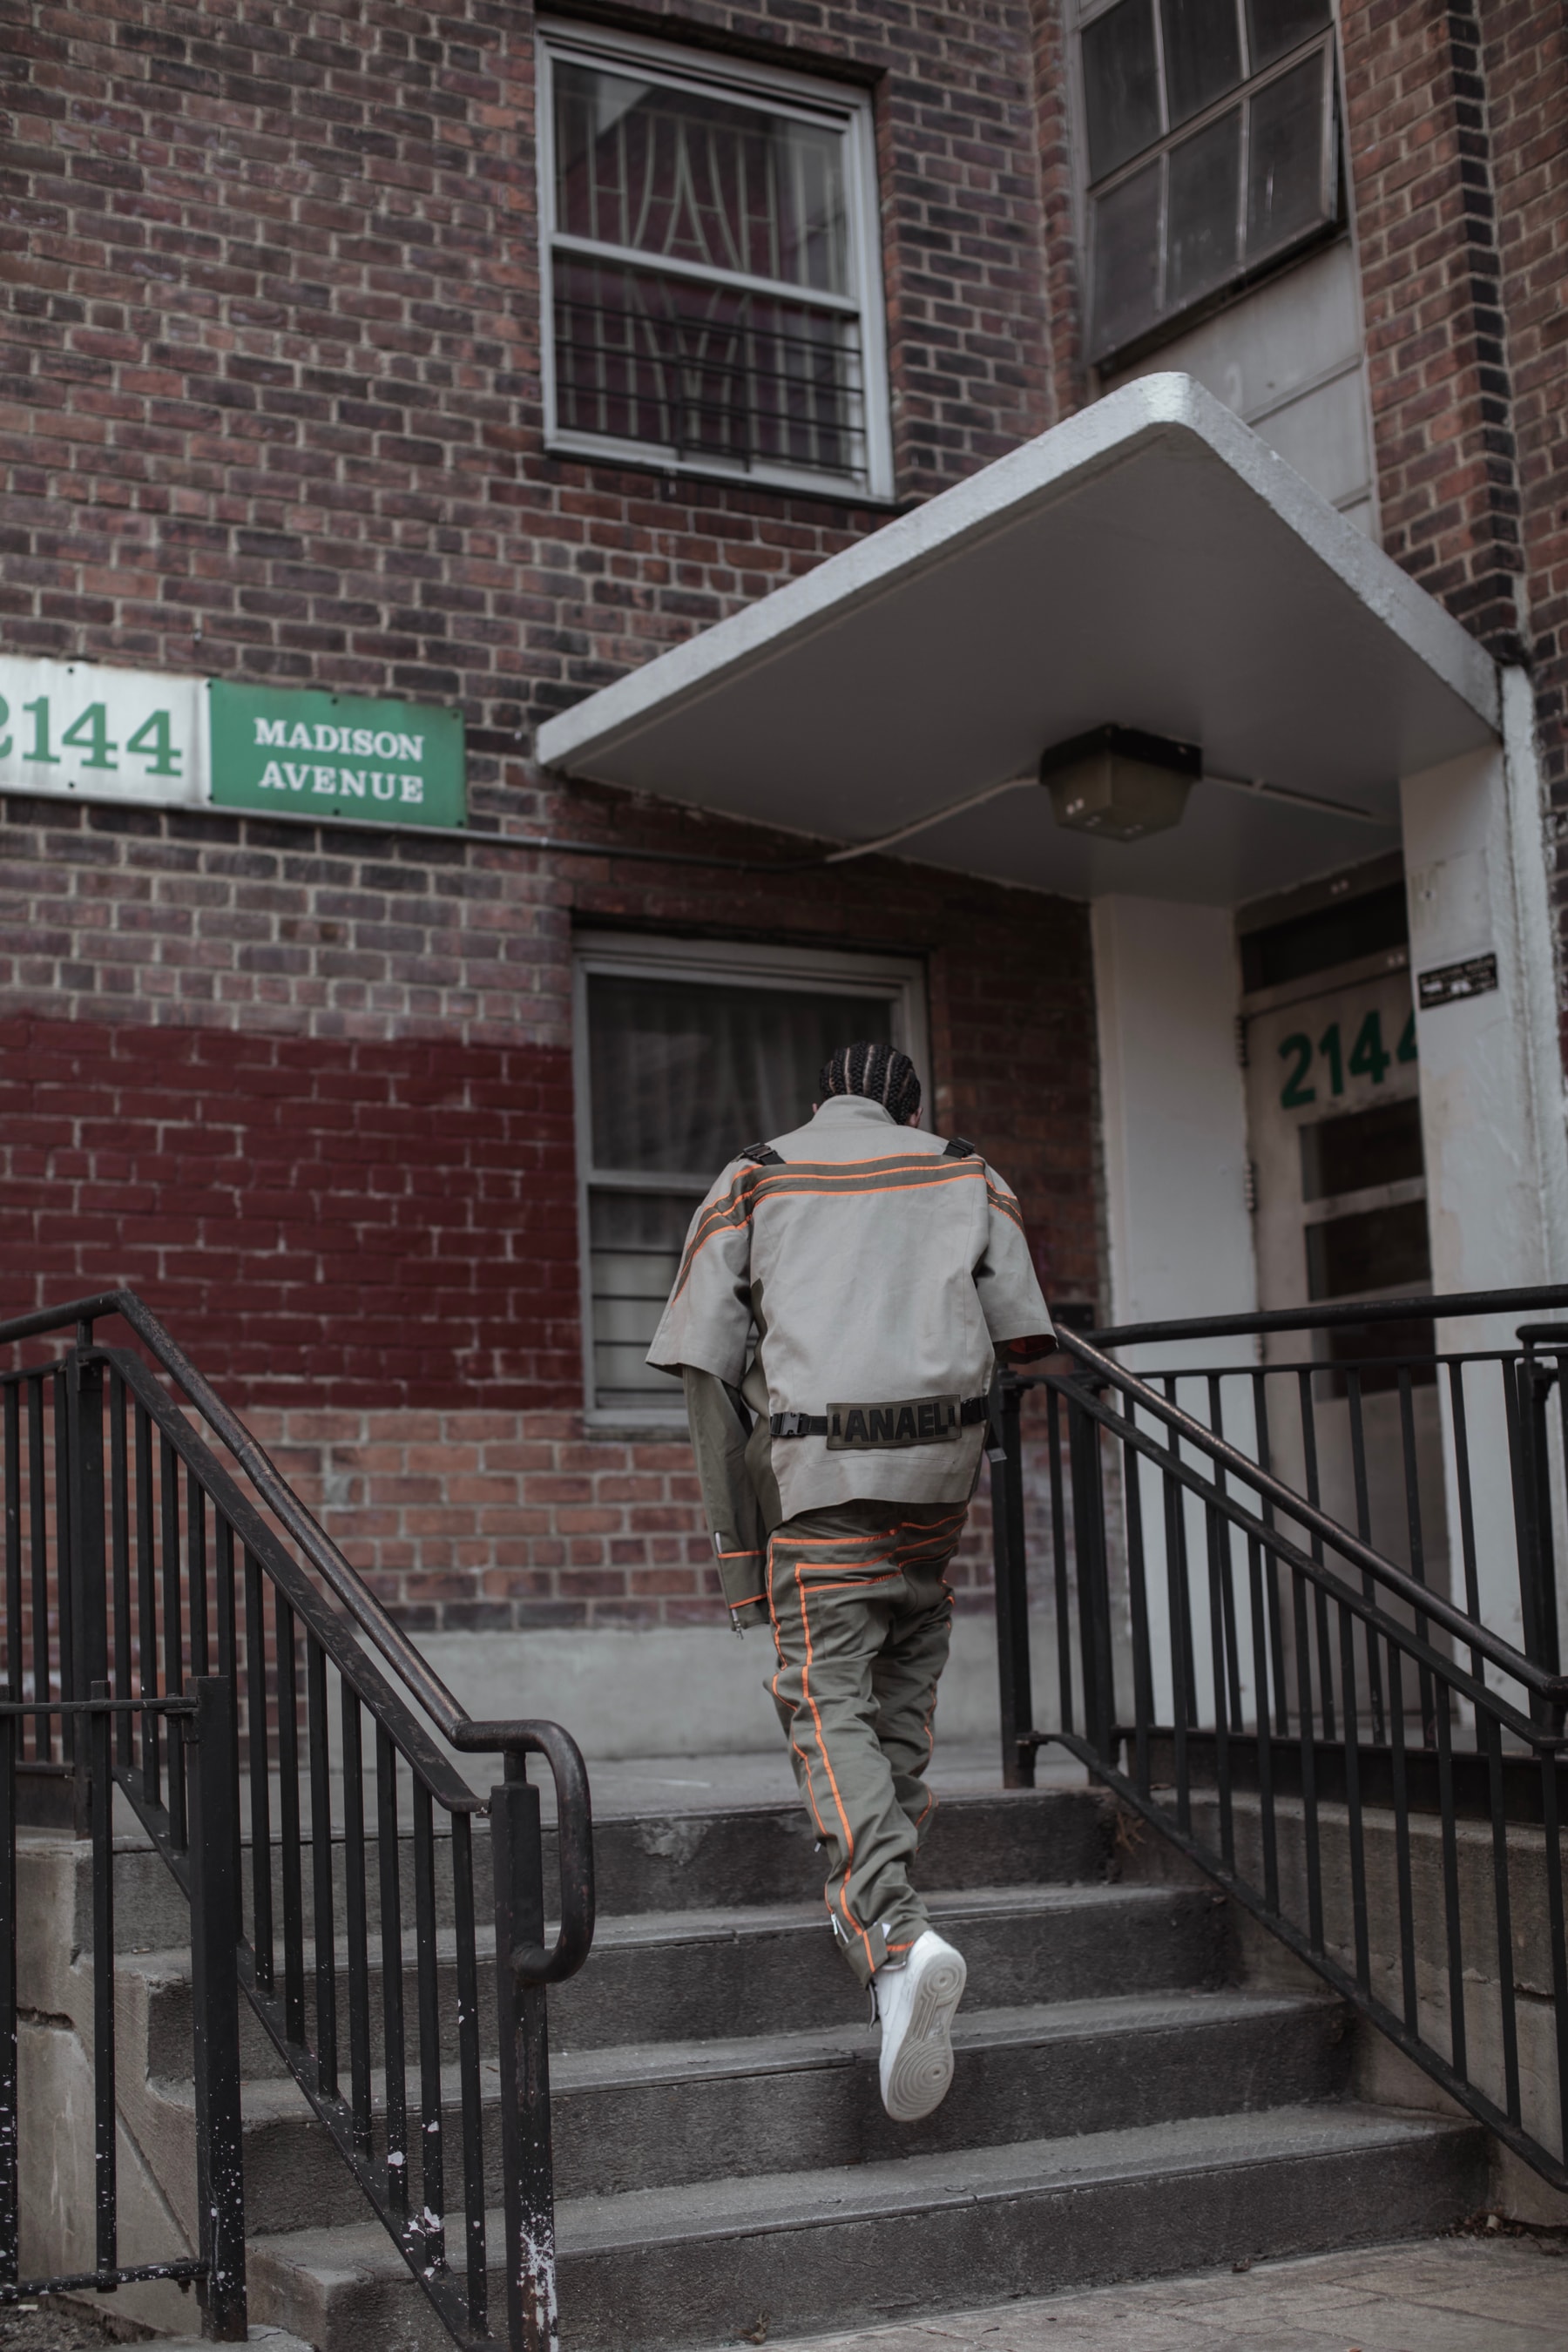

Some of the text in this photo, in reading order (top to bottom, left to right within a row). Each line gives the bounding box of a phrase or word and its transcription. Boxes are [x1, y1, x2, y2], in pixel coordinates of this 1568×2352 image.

[254, 717, 424, 761] MADISON
[259, 760, 424, 803] AVENUE
[844, 1402, 949, 1442] ANAEL
